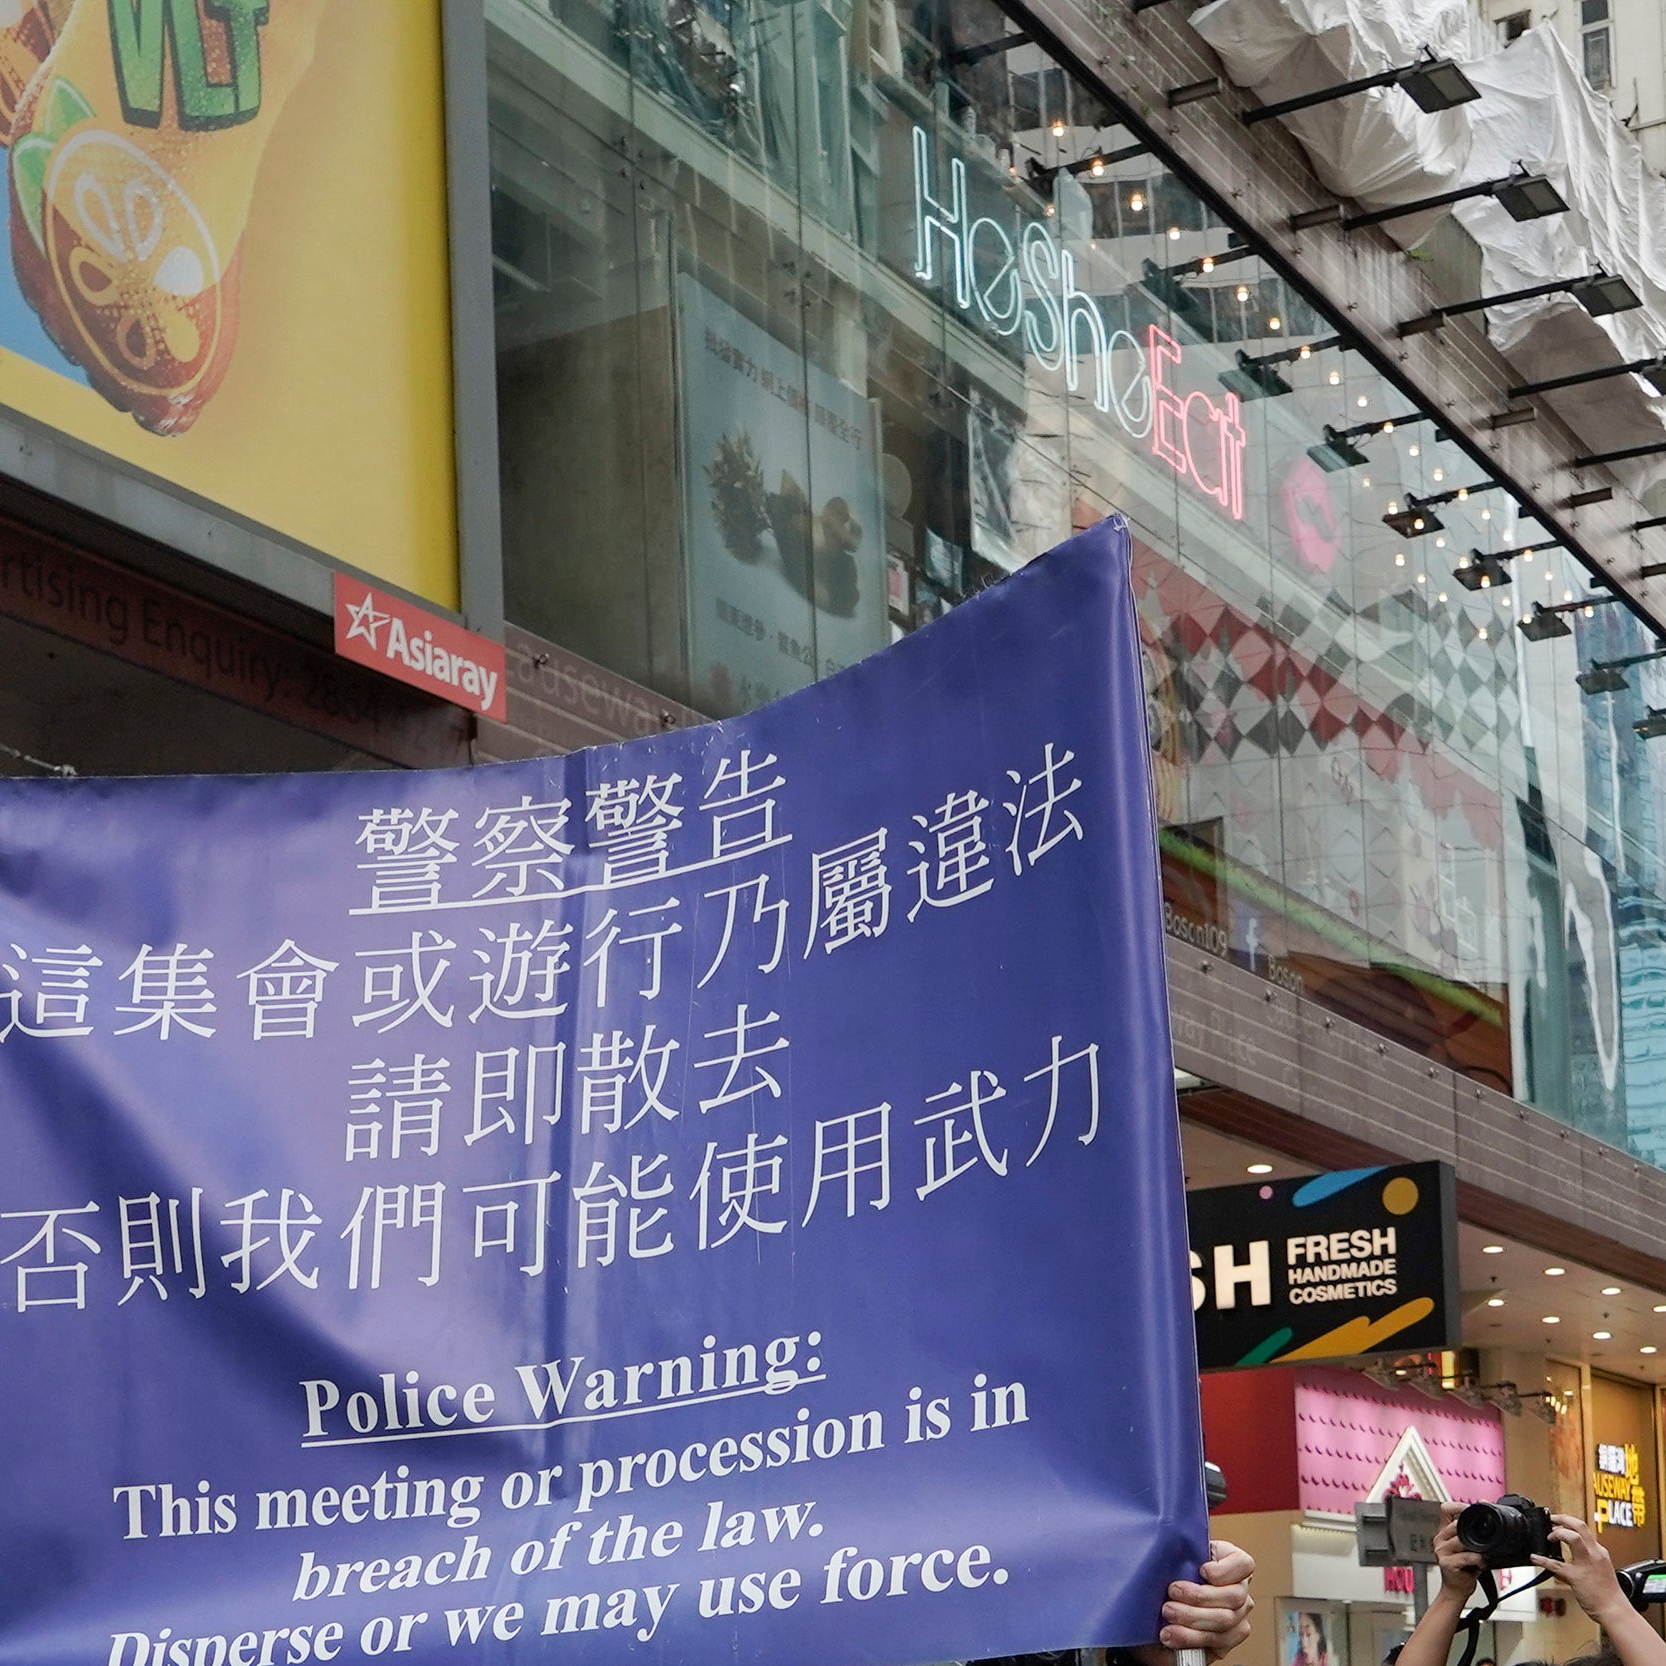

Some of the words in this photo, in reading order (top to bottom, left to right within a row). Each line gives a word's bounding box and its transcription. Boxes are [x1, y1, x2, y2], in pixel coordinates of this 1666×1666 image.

[385, 618, 499, 711] Asiaray
[354, 735, 795, 914] 警察警告
[343, 1002, 792, 1165] 請即散去
[1287, 1226, 1397, 1266] FRESH
[1287, 1257, 1397, 1286] HANDMADE
[1288, 1278, 1397, 1306] COSMETICS
[299, 1371, 494, 1438] Police
[522, 1330, 823, 1421] Warning:
[113, 1476, 238, 1541] This
[254, 1458, 486, 1532] meeting
[500, 1464, 554, 1511] or
[572, 1403, 887, 1516] procession
[903, 1385, 953, 1445] is
[968, 1372, 1031, 1432] in
[289, 1534, 492, 1603] breach
[508, 1514, 585, 1577] of
[585, 1510, 688, 1567] the
[696, 1498, 831, 1558] law.
[360, 1608, 431, 1656] or
[443, 1591, 526, 1648] we
[540, 1582, 683, 1644] may
[696, 1563, 804, 1620] use
[815, 1534, 1010, 1605] force.
